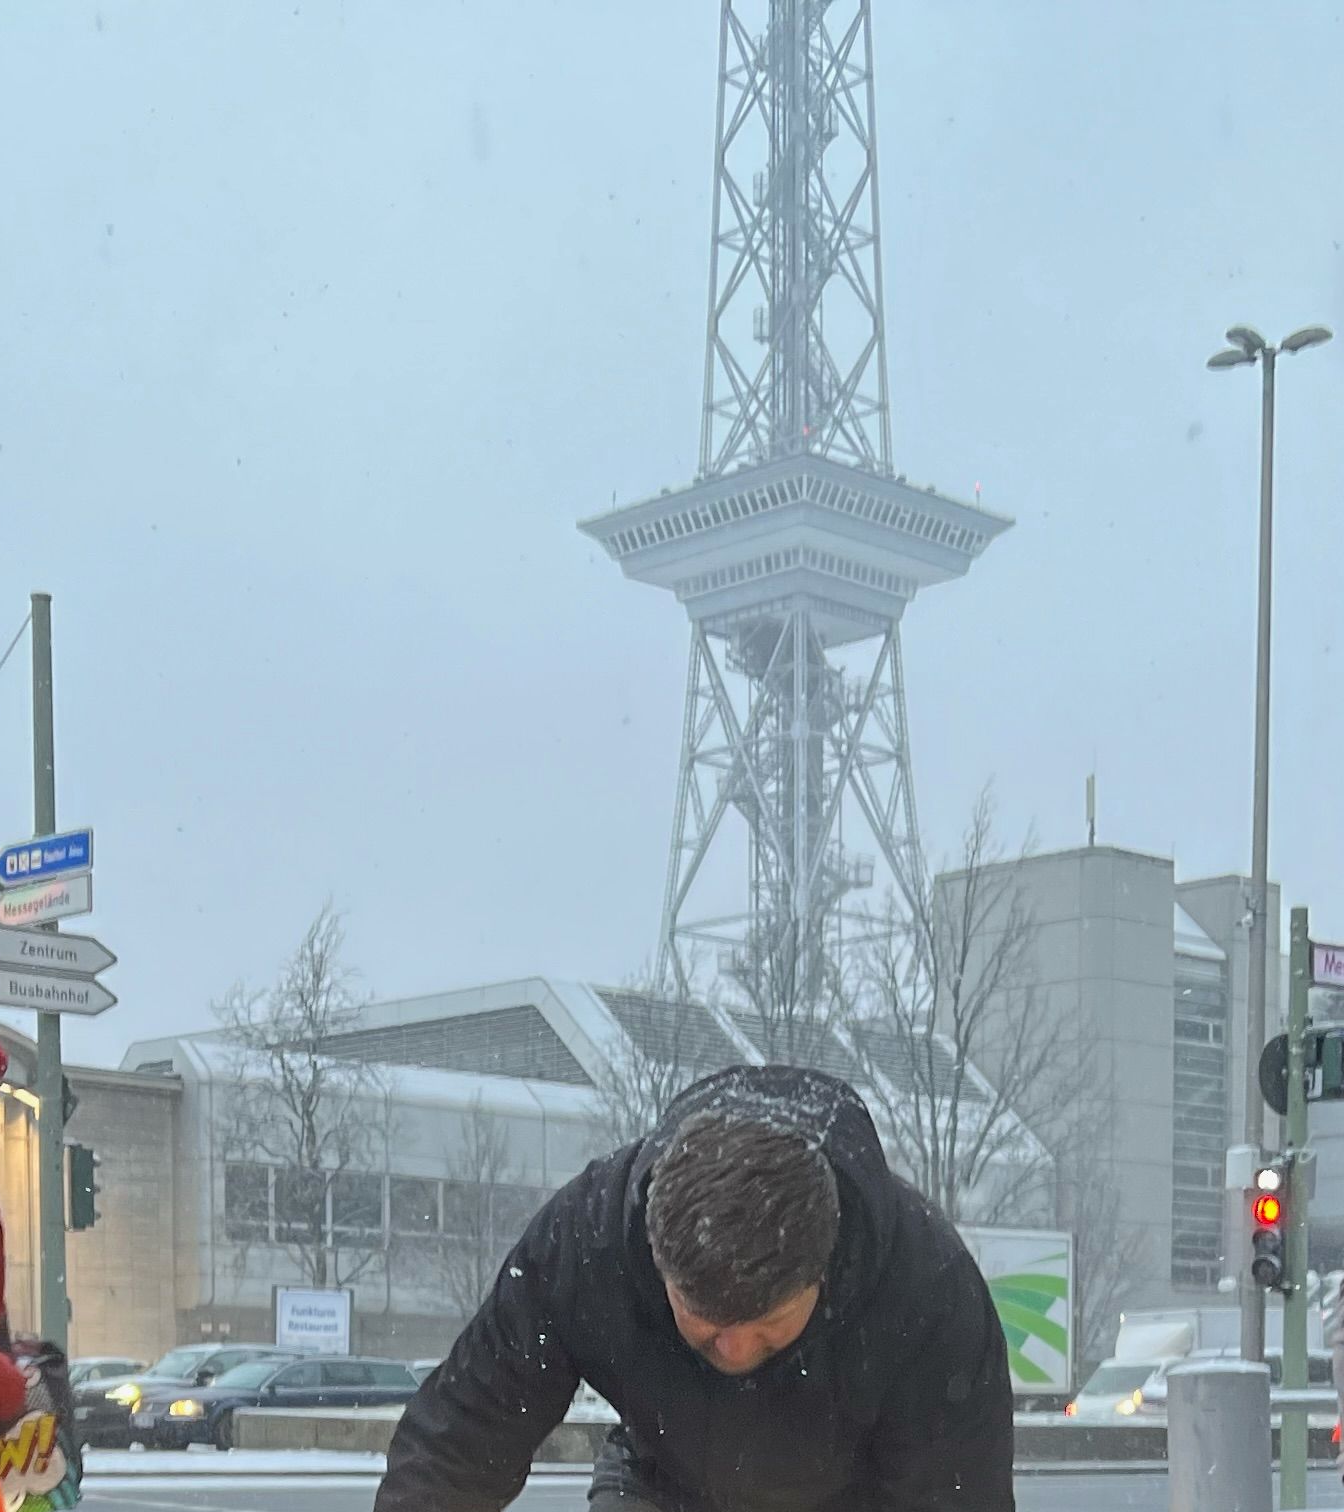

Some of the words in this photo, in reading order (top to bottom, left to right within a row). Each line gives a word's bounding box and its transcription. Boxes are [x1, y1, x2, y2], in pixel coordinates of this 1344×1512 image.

[4, 890, 70, 917] Messegelände
[20, 940, 78, 961] Zentrum
[9, 980, 89, 1004] Busbahnhof
